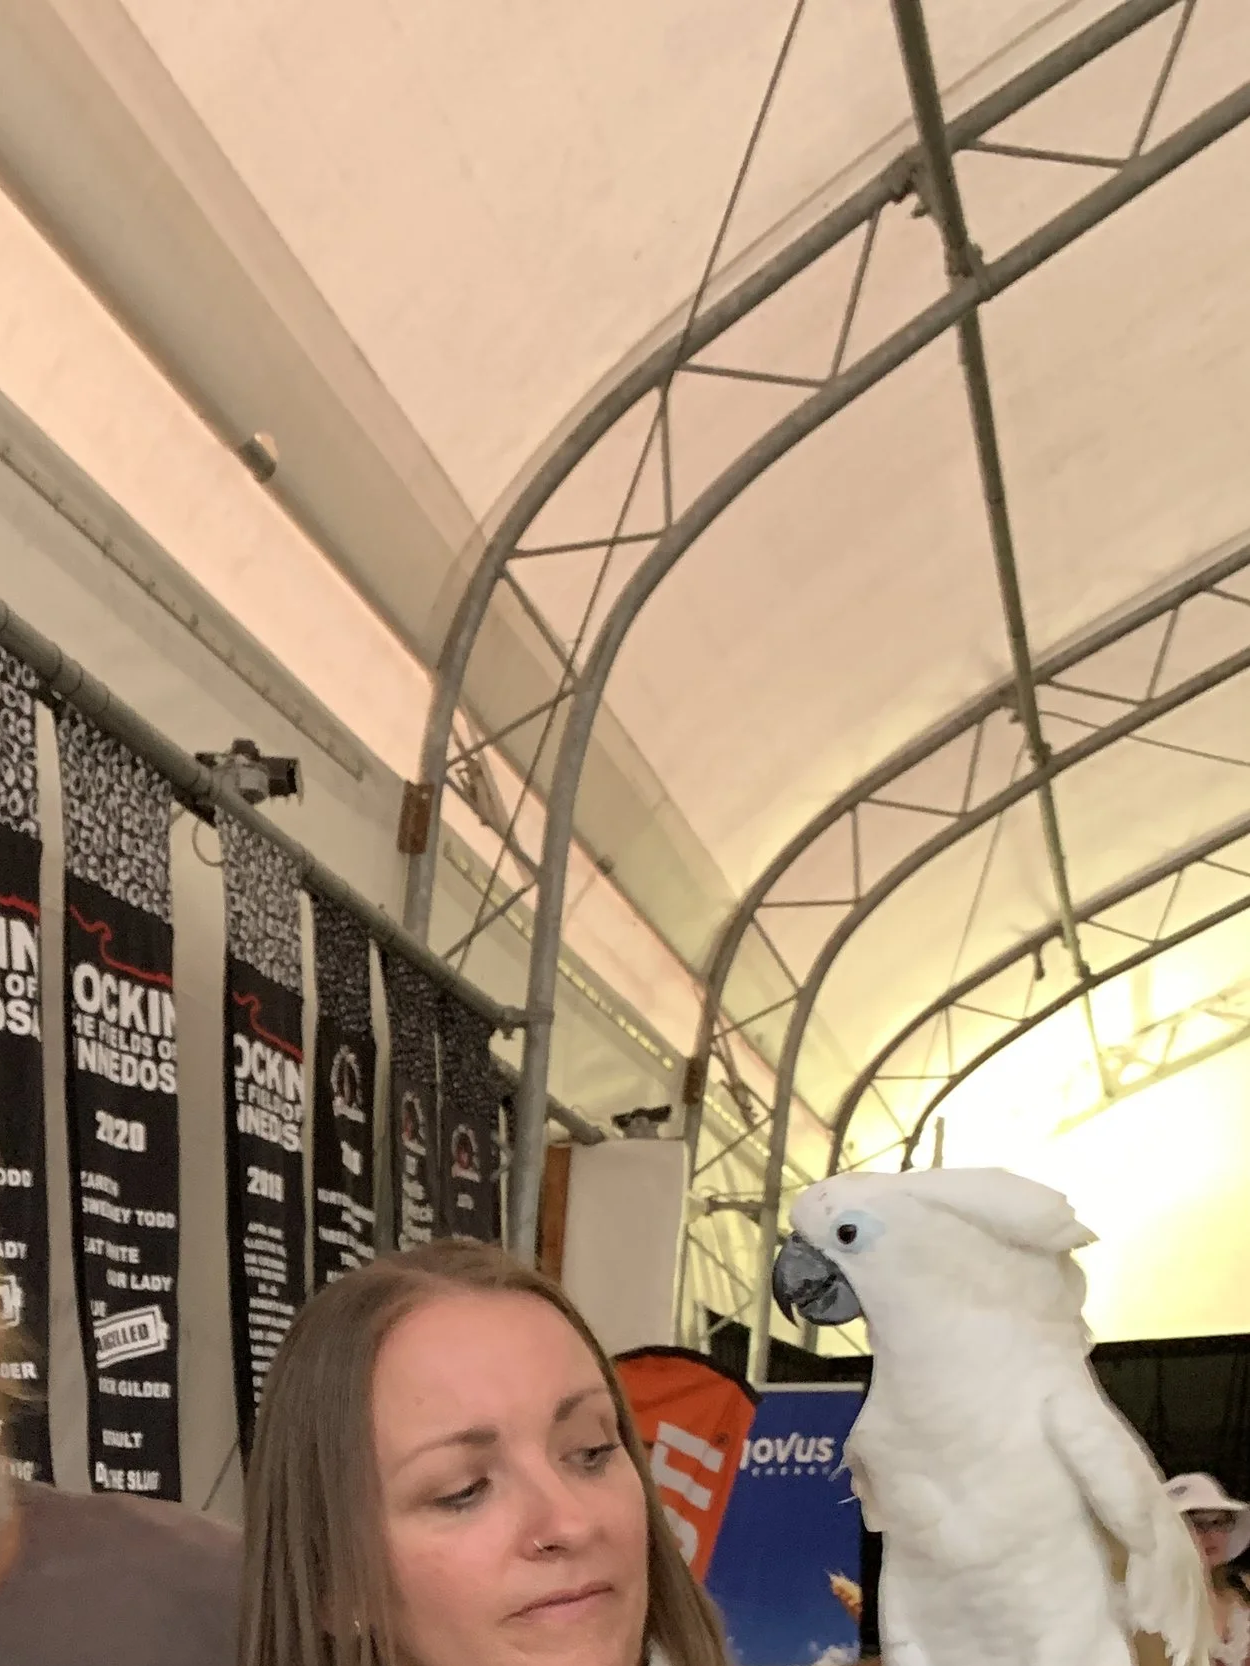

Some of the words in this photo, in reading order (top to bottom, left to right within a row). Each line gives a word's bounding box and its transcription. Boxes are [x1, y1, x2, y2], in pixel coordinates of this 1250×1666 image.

[4, 972, 38, 998] OF
[72, 963, 176, 1039] OCKIN
[129, 1271, 173, 1292] LADY
